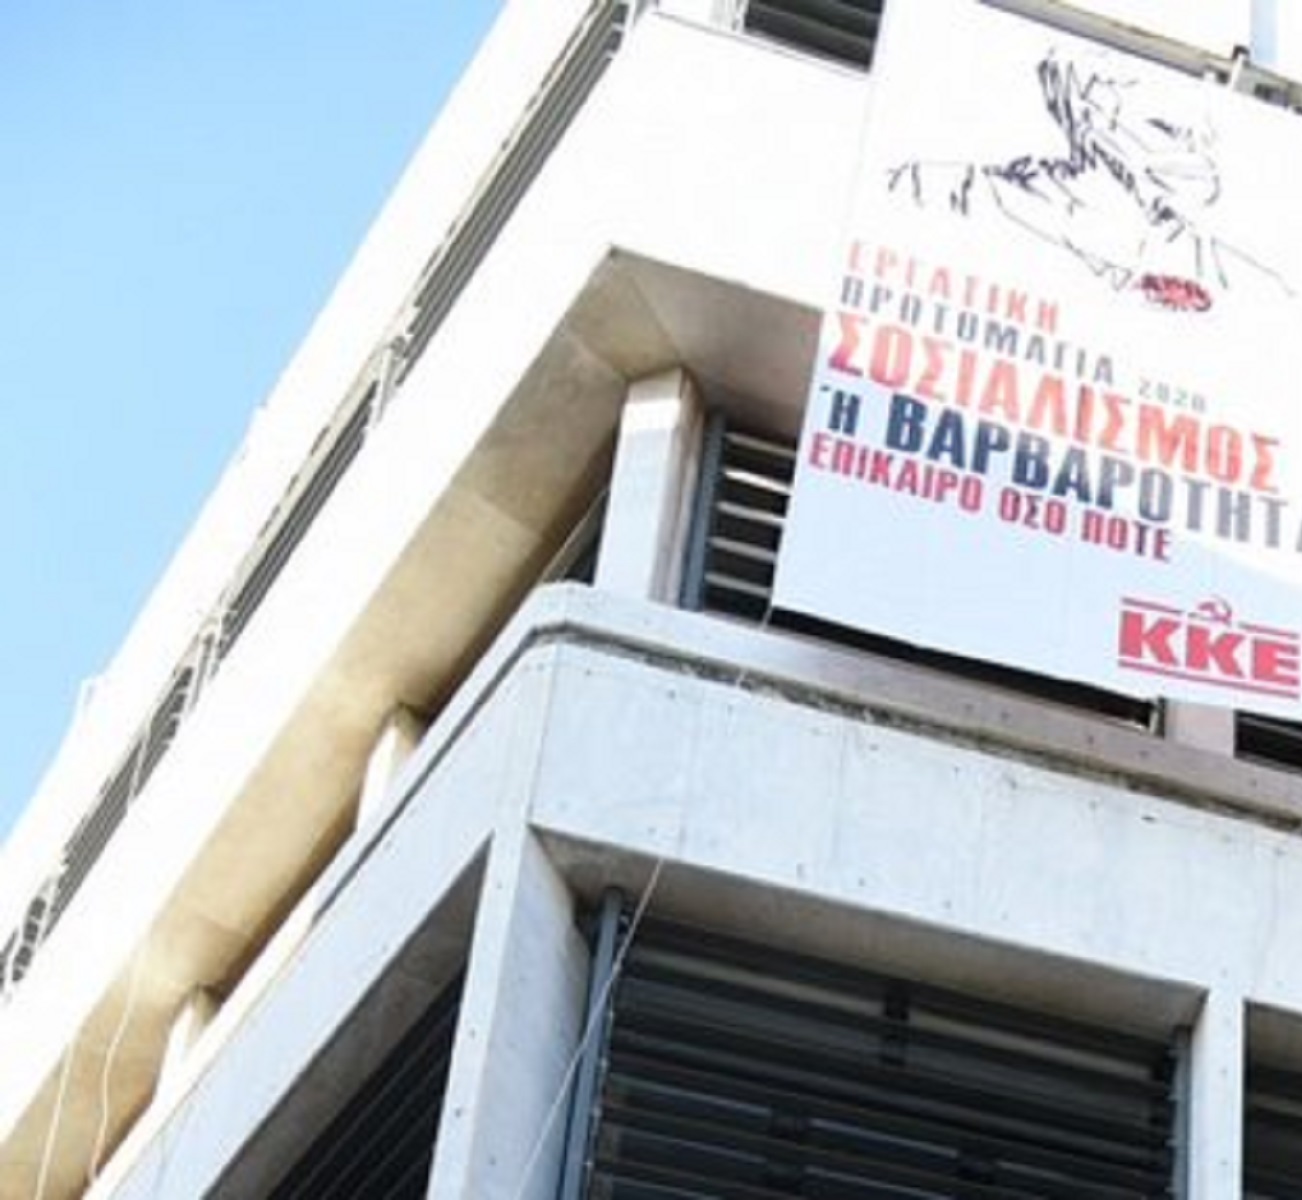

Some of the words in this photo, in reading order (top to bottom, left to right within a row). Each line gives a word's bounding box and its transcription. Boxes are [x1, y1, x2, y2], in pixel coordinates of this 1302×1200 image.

[848, 239, 1058, 335] ΕΡΓΑΤΙΚΗ
[828, 310, 1280, 494] ΣΟΣΙΑΛΙΣΜΟΣ
[1138, 377, 1206, 413] 2020
[809, 431, 984, 512] ΕΠΙΚΑΙΡΟ
[998, 487, 1067, 534] ΟΣΟ
[1081, 509, 1170, 564] ΠΟΤΕ
[1118, 609, 1300, 687] ΚΚΕ
